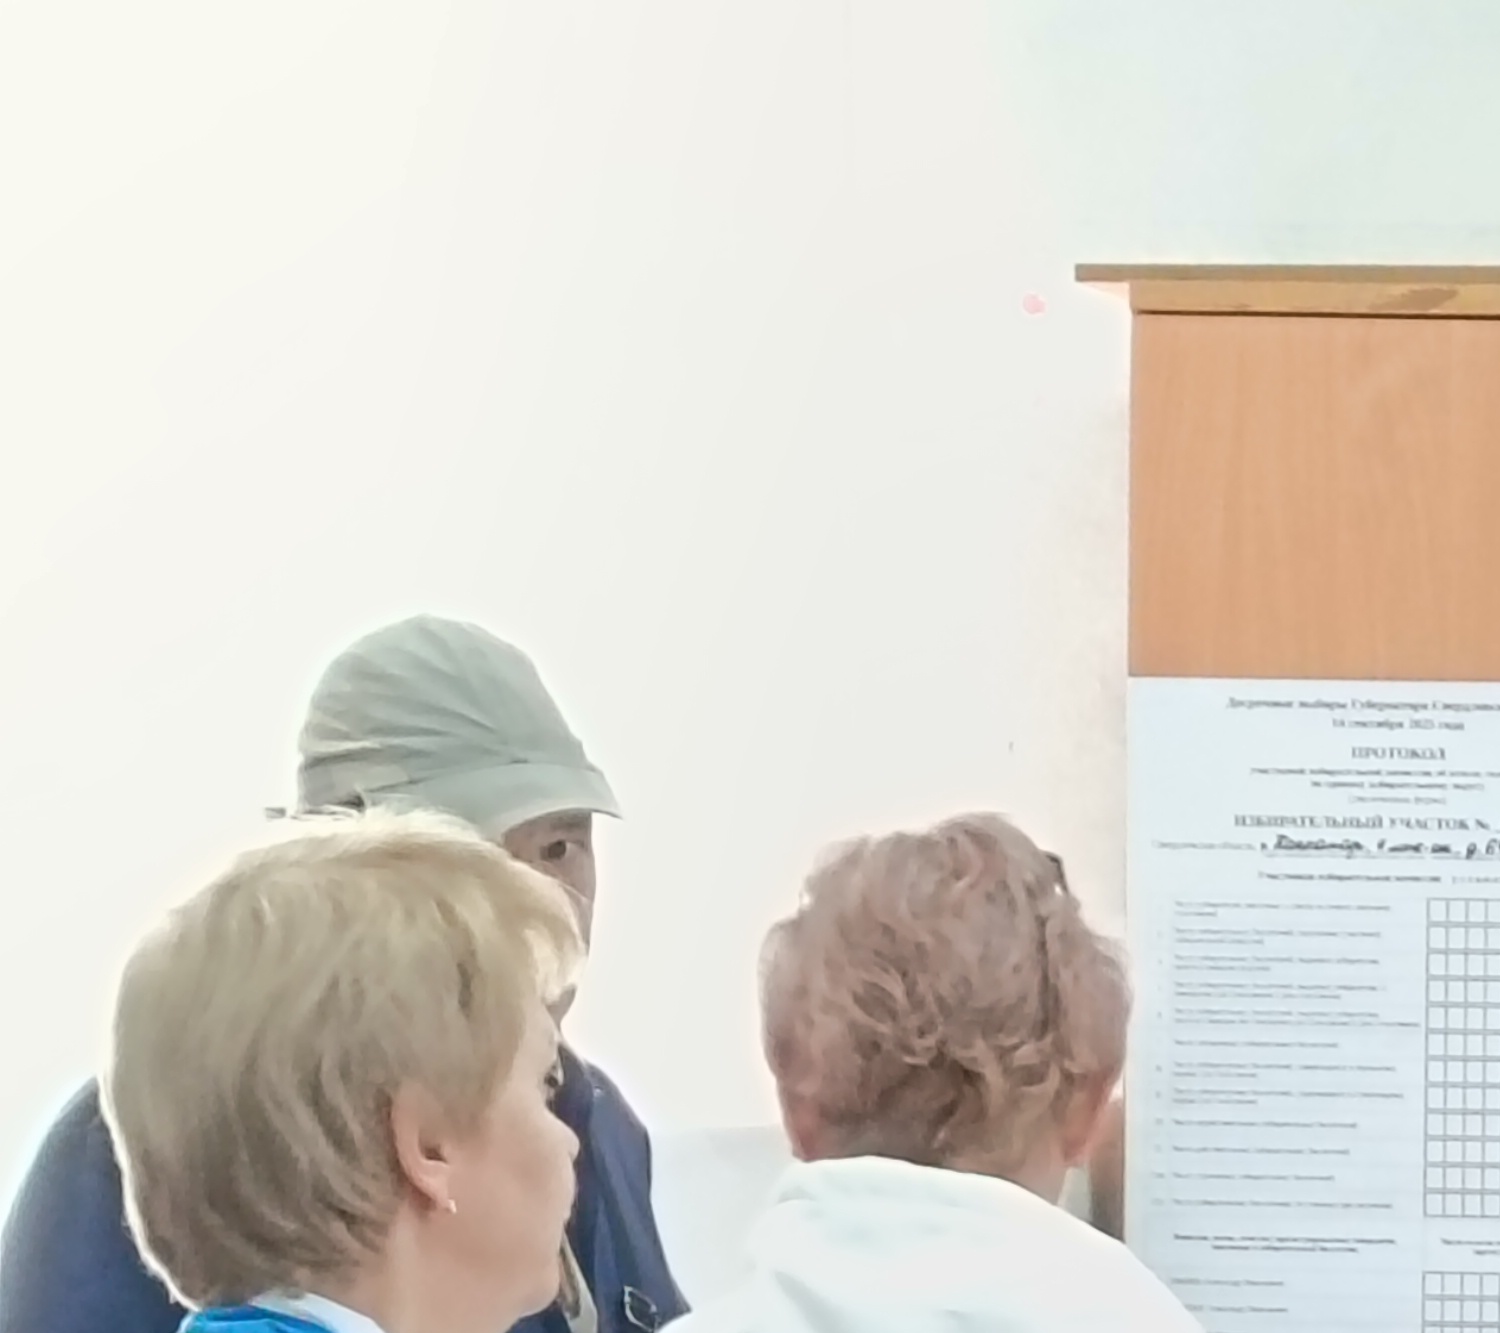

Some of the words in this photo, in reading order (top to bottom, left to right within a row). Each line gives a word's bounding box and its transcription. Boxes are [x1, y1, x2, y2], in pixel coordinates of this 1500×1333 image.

[1351, 747, 1446, 760] ПРОТОКОЛ
[1234, 814, 1383, 829] ИЗБИРАТЕЛЬНЫЙ
[1388, 817, 1470, 831] УЧАСТОК
